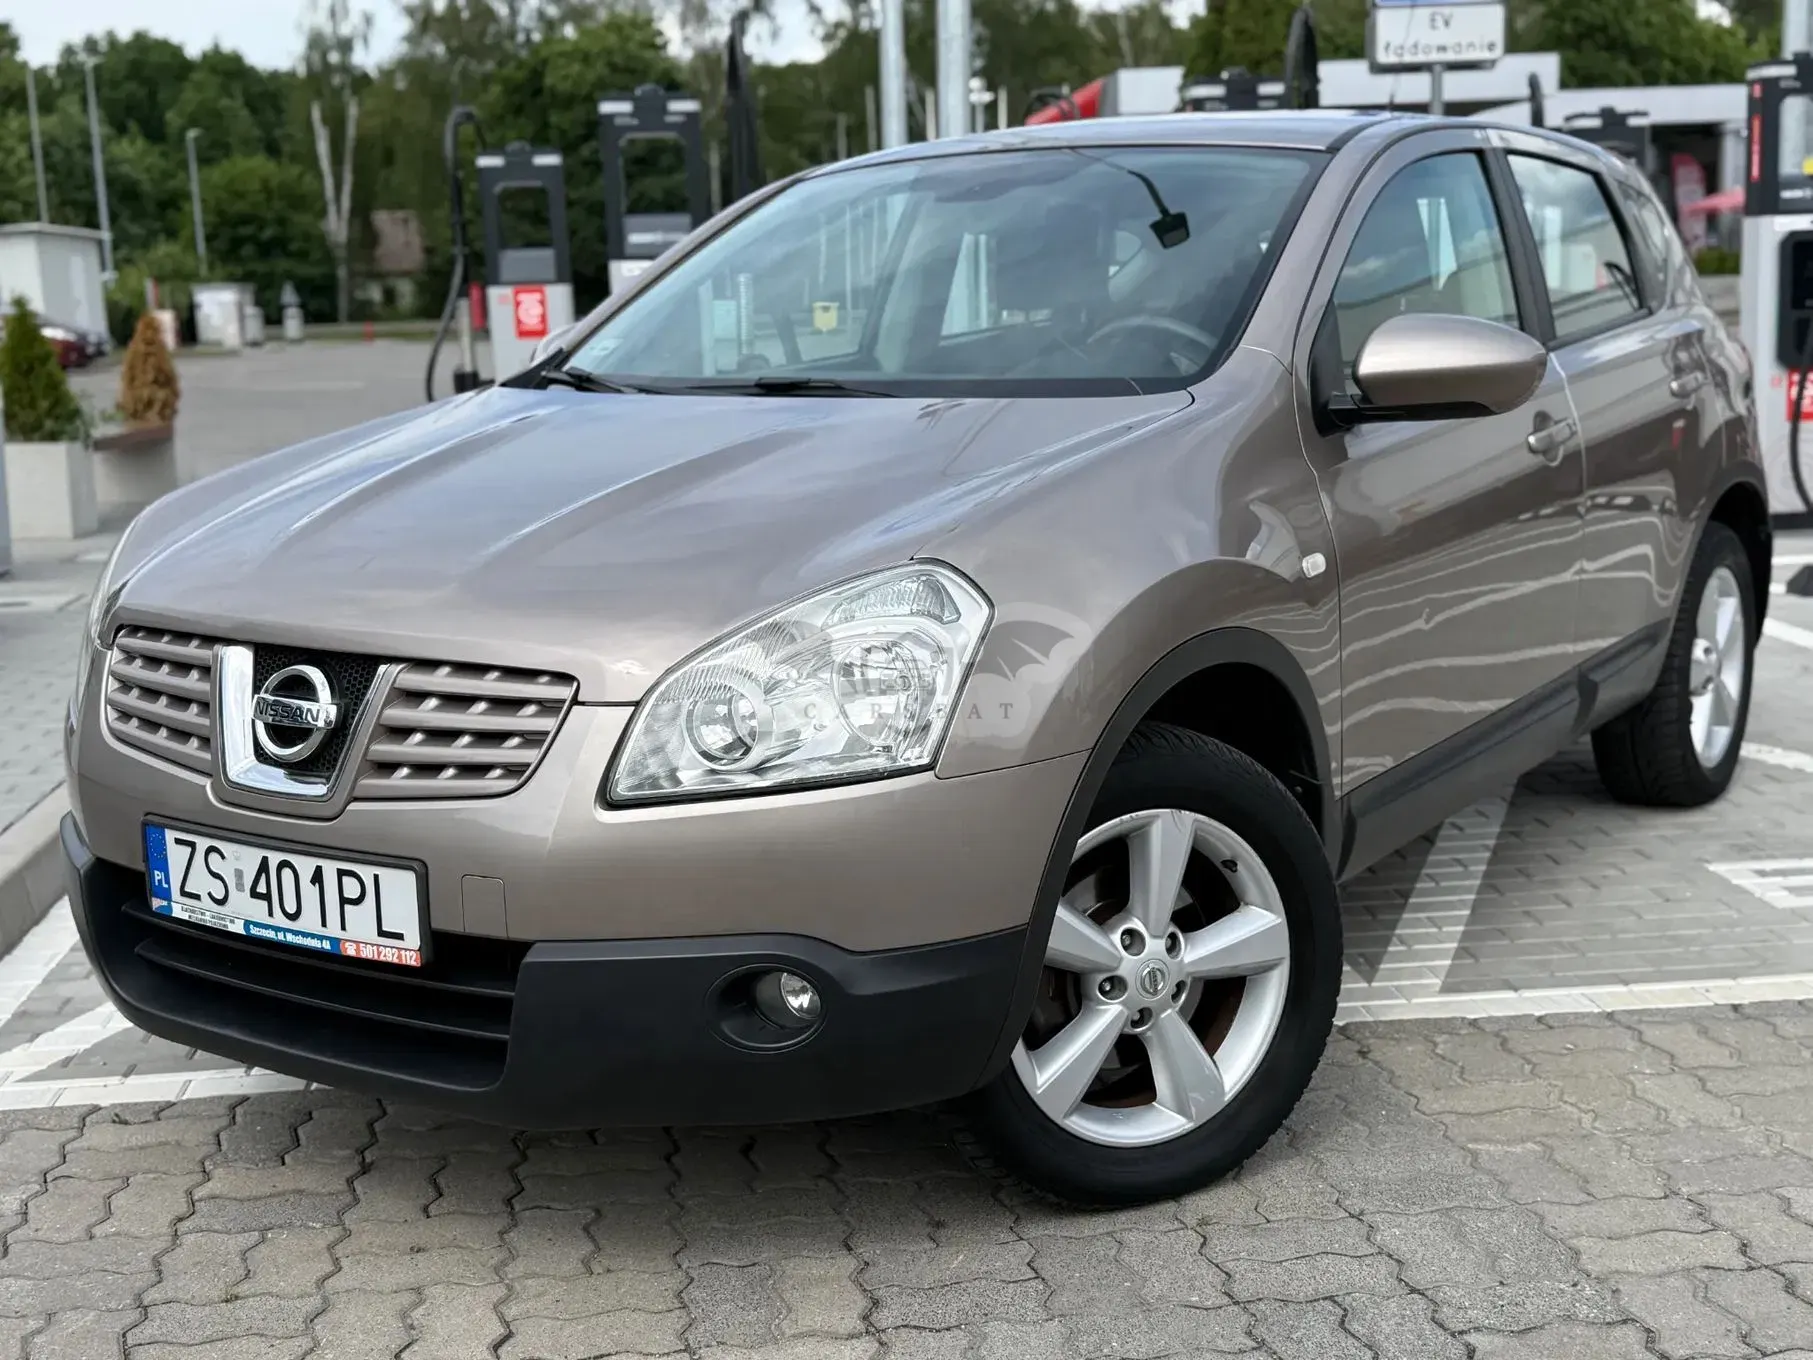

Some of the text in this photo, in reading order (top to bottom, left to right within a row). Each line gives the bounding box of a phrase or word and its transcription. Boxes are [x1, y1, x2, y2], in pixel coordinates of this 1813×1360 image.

[1428, 11, 1453, 30] EV
[254, 700, 321, 723] NISSAN
[154, 869, 169, 888] PL
[173, 836, 405, 942] ZS 401PL
[359, 942, 417, 966] 501 292 112
